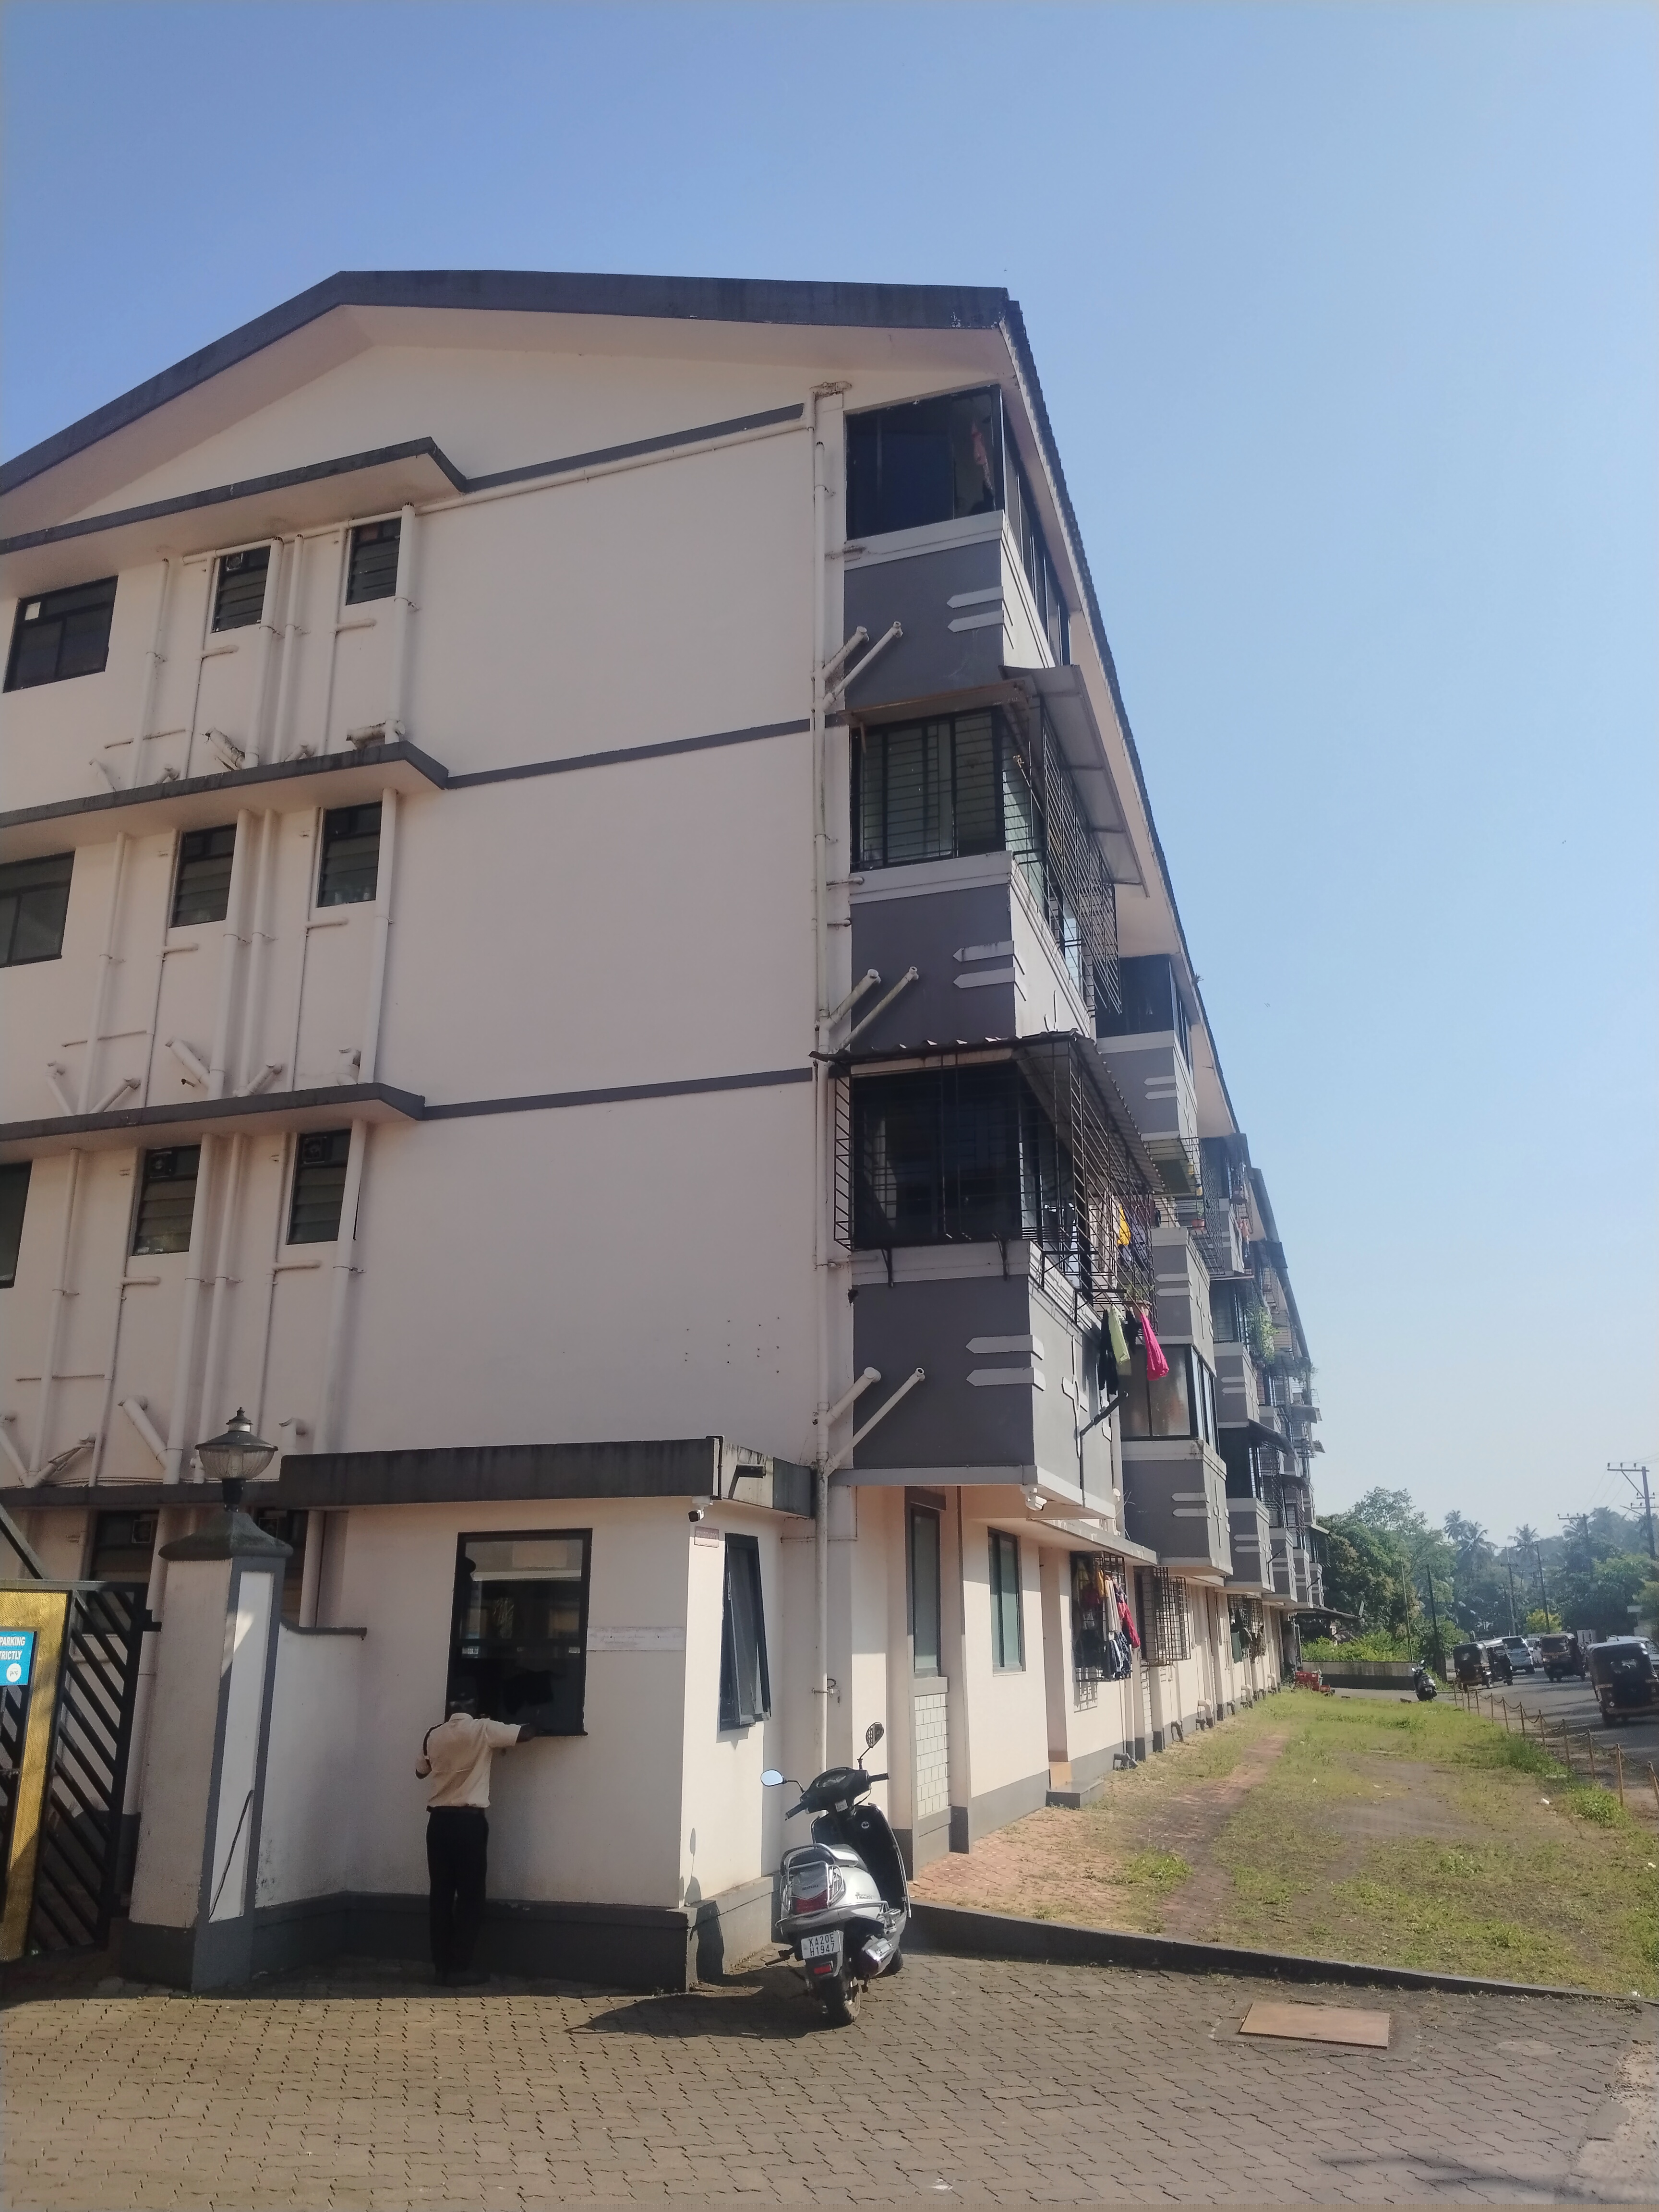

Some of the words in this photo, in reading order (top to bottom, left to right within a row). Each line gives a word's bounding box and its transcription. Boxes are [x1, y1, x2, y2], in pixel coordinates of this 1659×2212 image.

[0, 1636, 25, 1646] PARKING
[809, 1934, 835, 1947] KA20E
[810, 1943, 835, 1956] H1947
